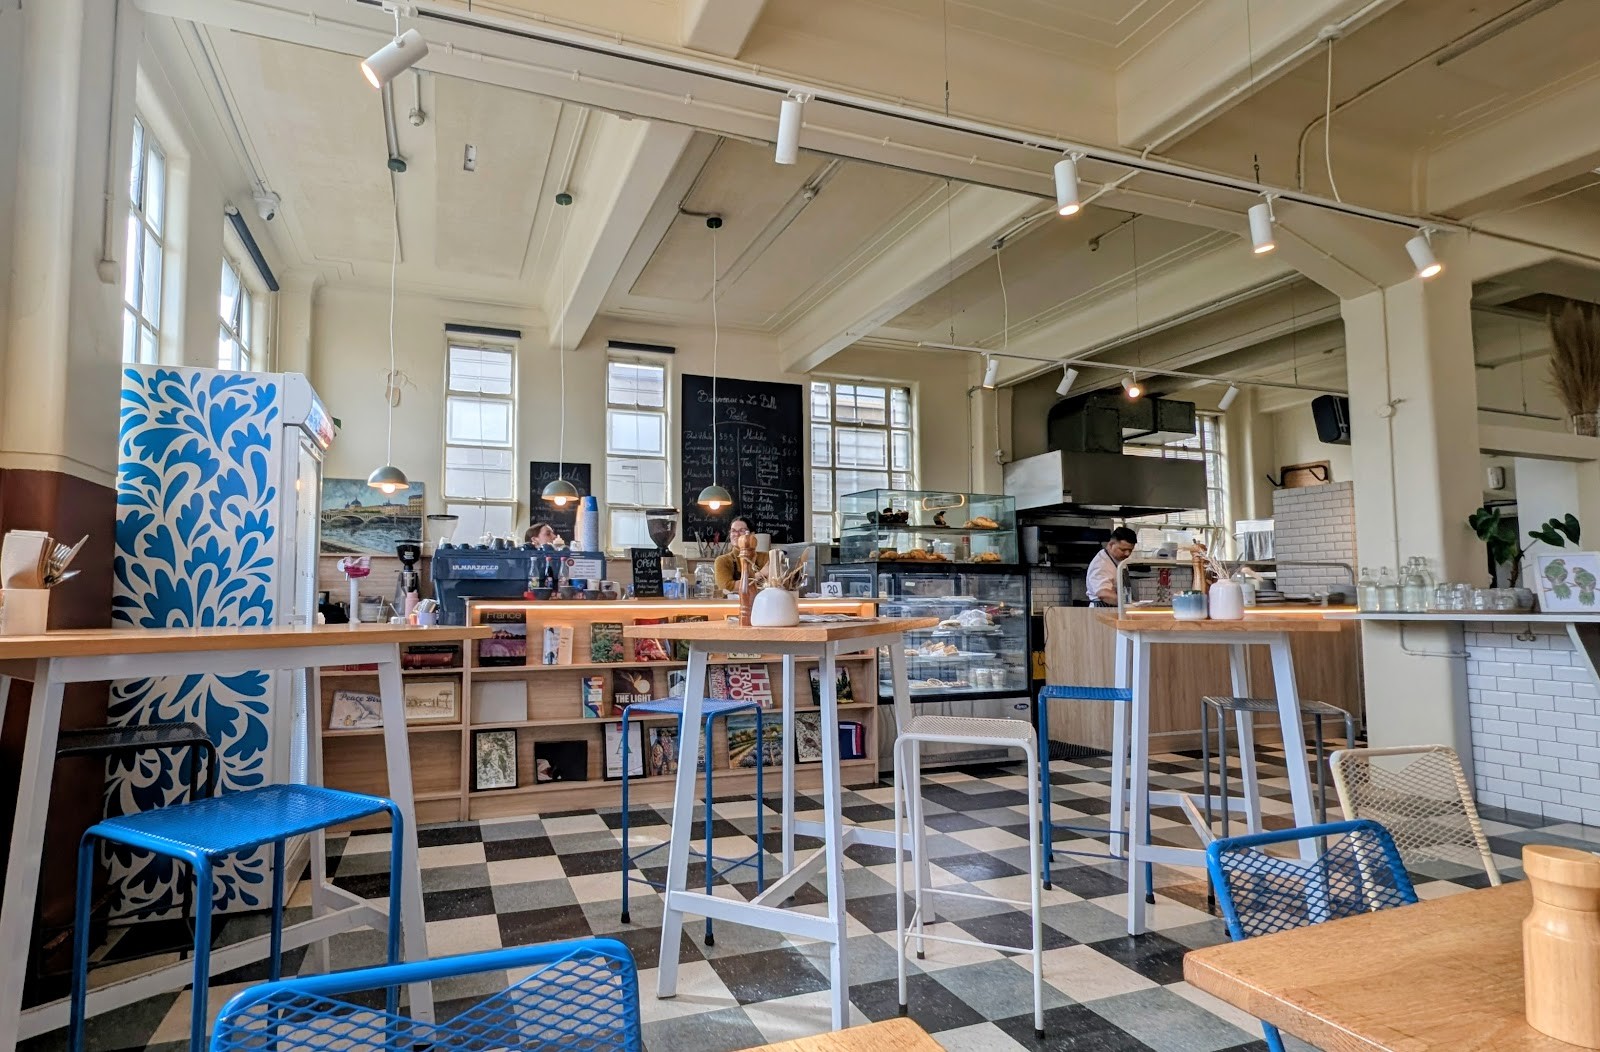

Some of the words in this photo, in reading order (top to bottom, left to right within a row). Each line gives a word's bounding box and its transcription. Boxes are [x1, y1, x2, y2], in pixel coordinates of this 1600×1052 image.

[740, 457, 753, 467] Tea
[636, 558, 657, 568] OPEN
[826, 584, 838, 595] 20
[727, 664, 744, 700] BOO
[740, 664, 754, 703] TRAVE
[750, 664, 773, 707] THE
[339, 693, 364, 701] Peace
[615, 694, 630, 703] THE
[631, 694, 651, 703] LIGHT
